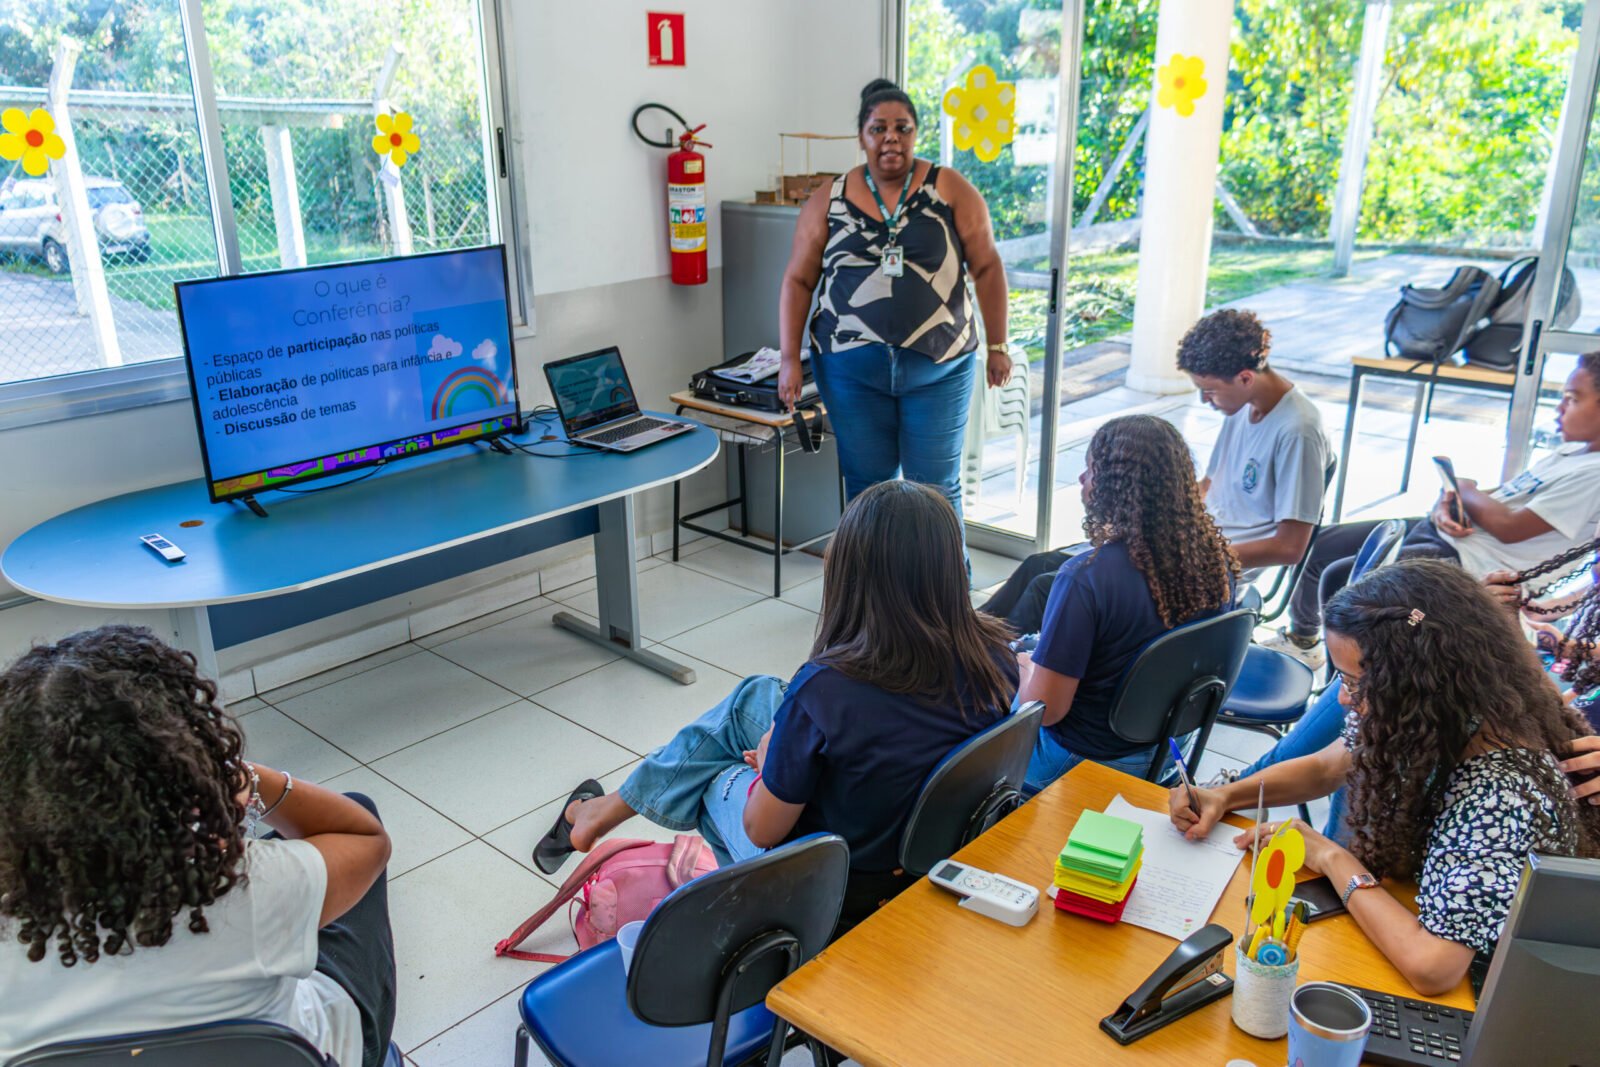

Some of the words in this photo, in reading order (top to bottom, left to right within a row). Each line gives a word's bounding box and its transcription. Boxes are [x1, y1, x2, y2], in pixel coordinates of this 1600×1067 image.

[314, 280, 330, 298] O
[335, 278, 371, 297] que
[375, 273, 387, 289] é
[293, 295, 411, 327] Conferência?
[212, 349, 264, 368] Espaço
[266, 345, 283, 359] de
[286, 332, 367, 358] participação
[370, 329, 392, 342] nas
[394, 321, 440, 339] políticas
[206, 367, 262, 388] públicas
[218, 377, 298, 402] Elaboração
[301, 373, 317, 387] de
[320, 364, 370, 386] políticas
[372, 359, 399, 377] para
[400, 350, 443, 369] infância
[445, 350, 453, 360] e
[212, 394, 299, 421] adolescência
[224, 411, 298, 436] Discussão
[300, 407, 316, 420] de
[319, 400, 357, 417] temas
